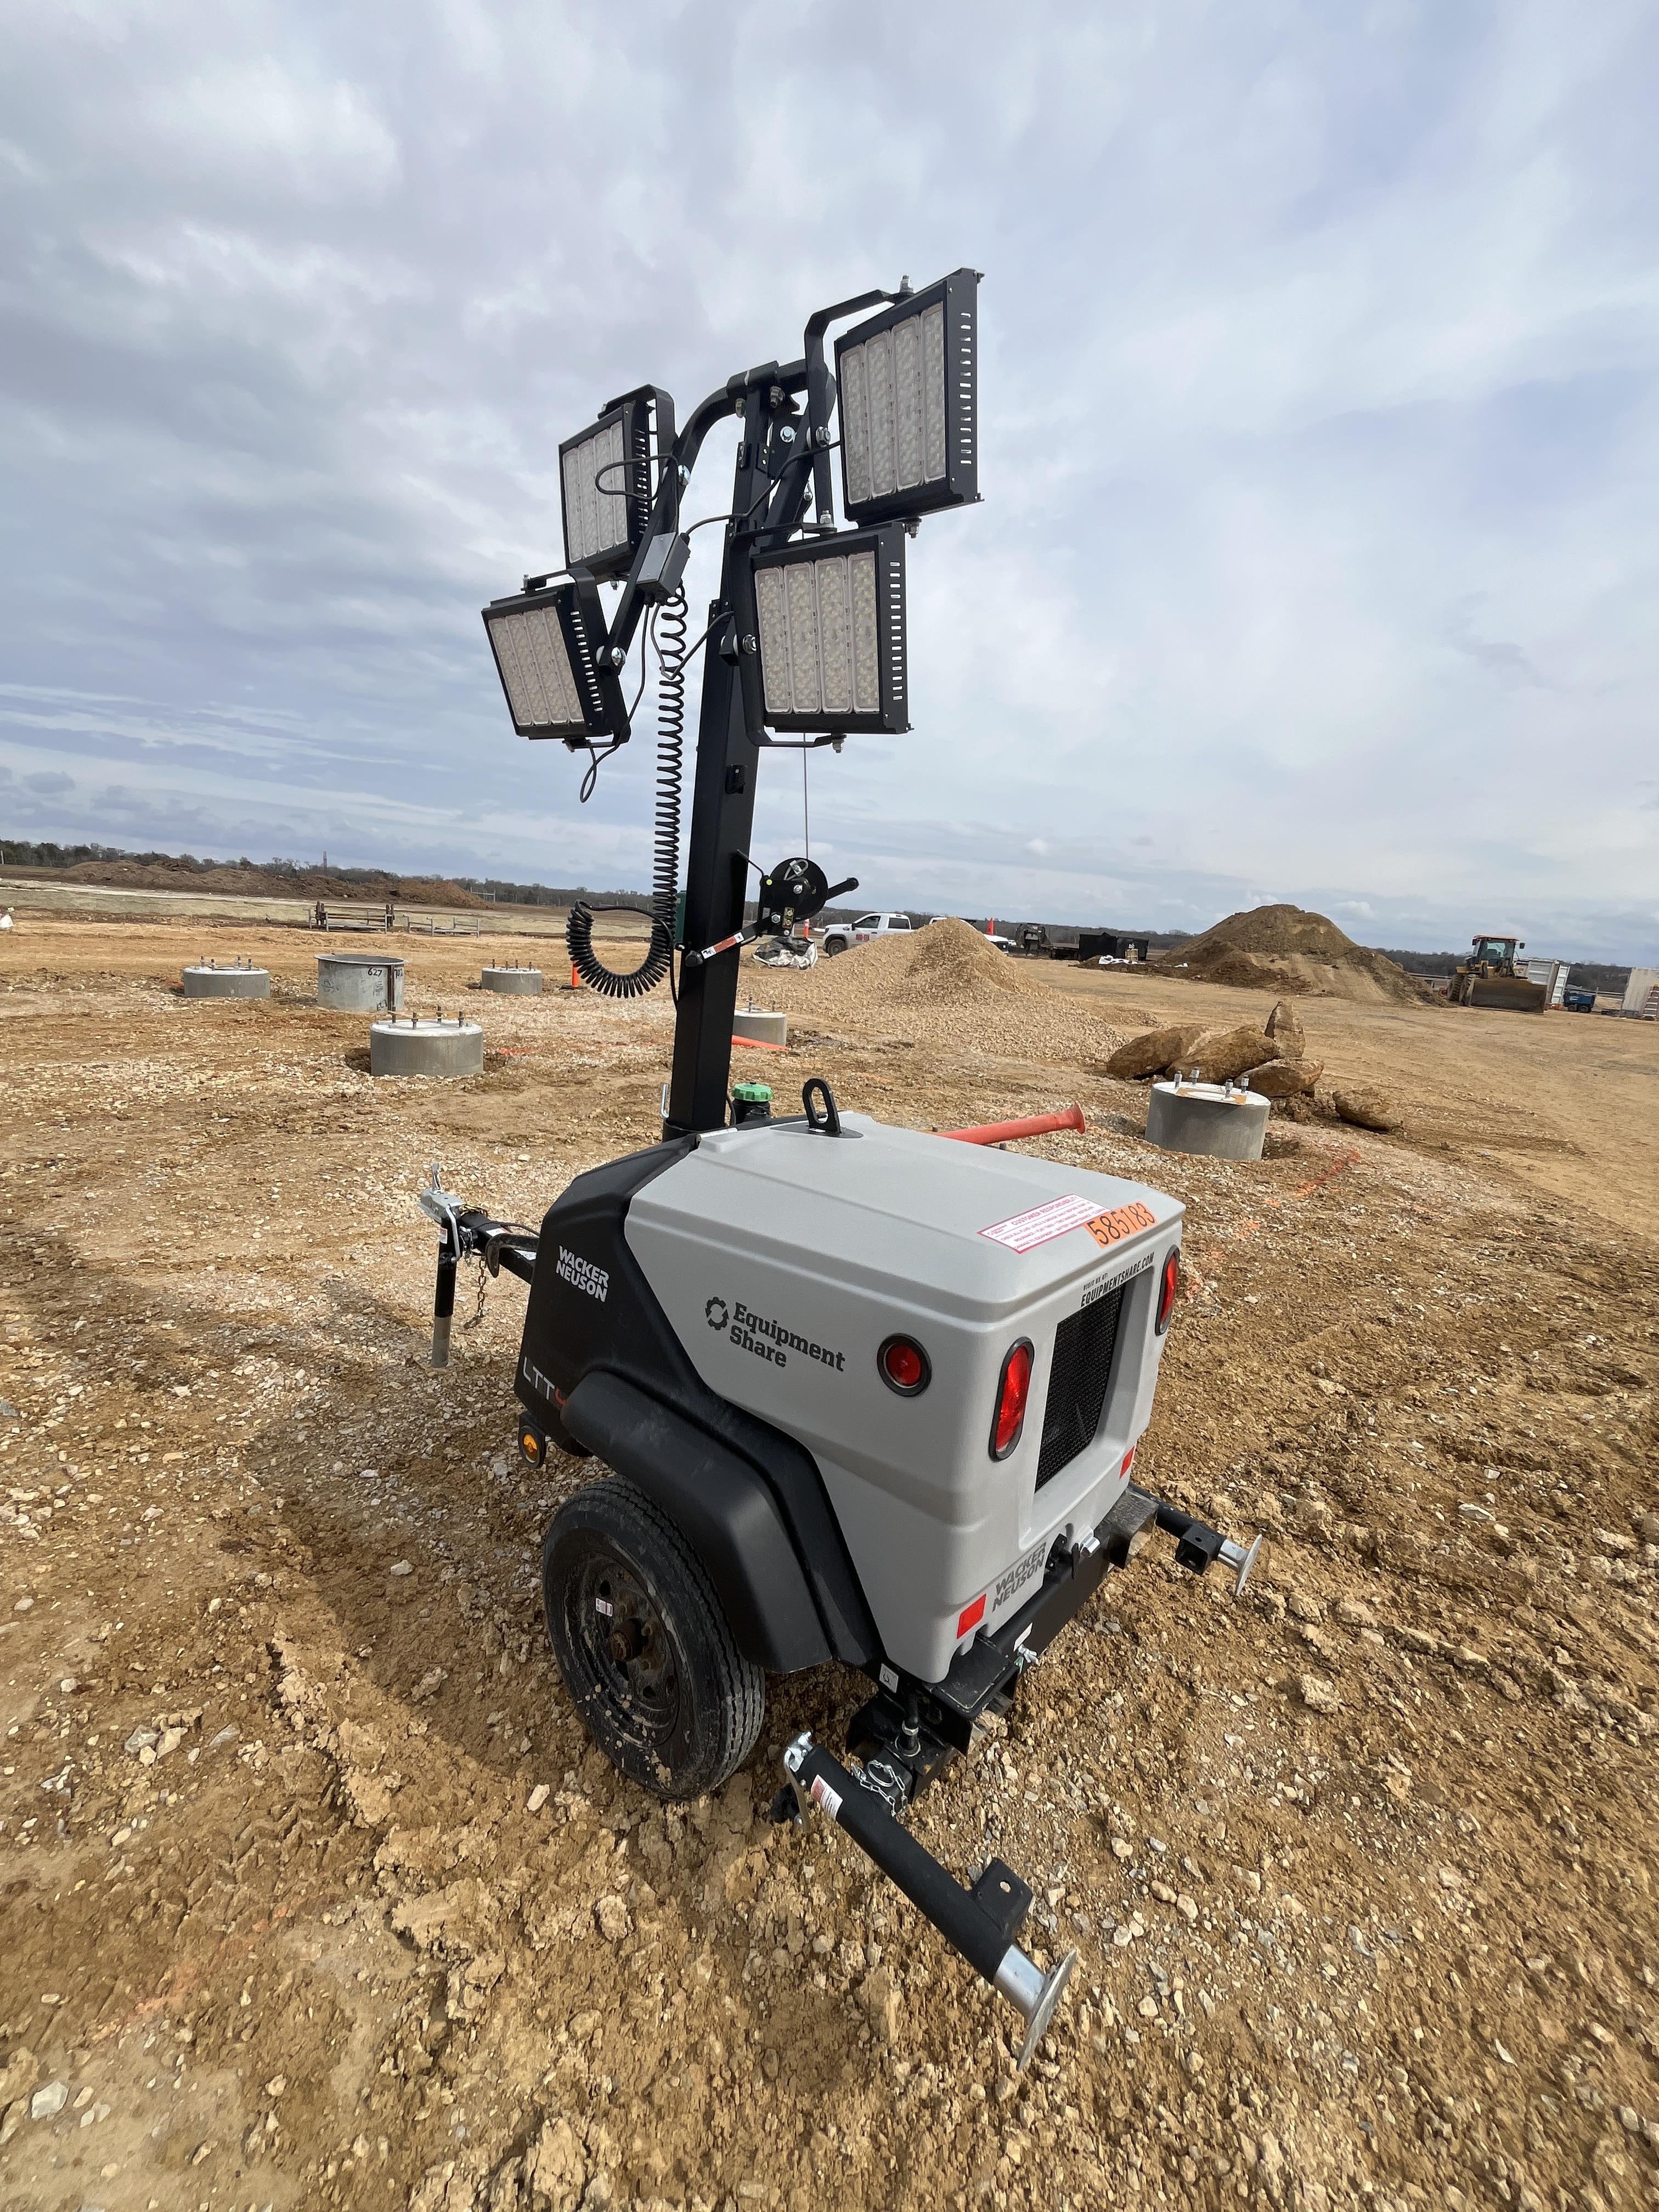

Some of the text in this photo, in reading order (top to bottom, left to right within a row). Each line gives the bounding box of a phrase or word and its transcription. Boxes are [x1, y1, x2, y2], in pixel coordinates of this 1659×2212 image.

[368, 967, 382, 977] 627
[1011, 1211, 1042, 1224] CUSTOMER
[1087, 1203, 1155, 1245] 585183
[556, 1260, 608, 1302] NEUSON
[558, 1245, 610, 1288] WACKER
[1081, 1252, 1155, 1307] EQUIPMENTSHARE.COM
[730, 1325, 787, 1368] Share
[732, 1302, 846, 1372] Equipment
[992, 1554, 1045, 1612] NEUSON
[996, 1542, 1047, 1595] WACKER
